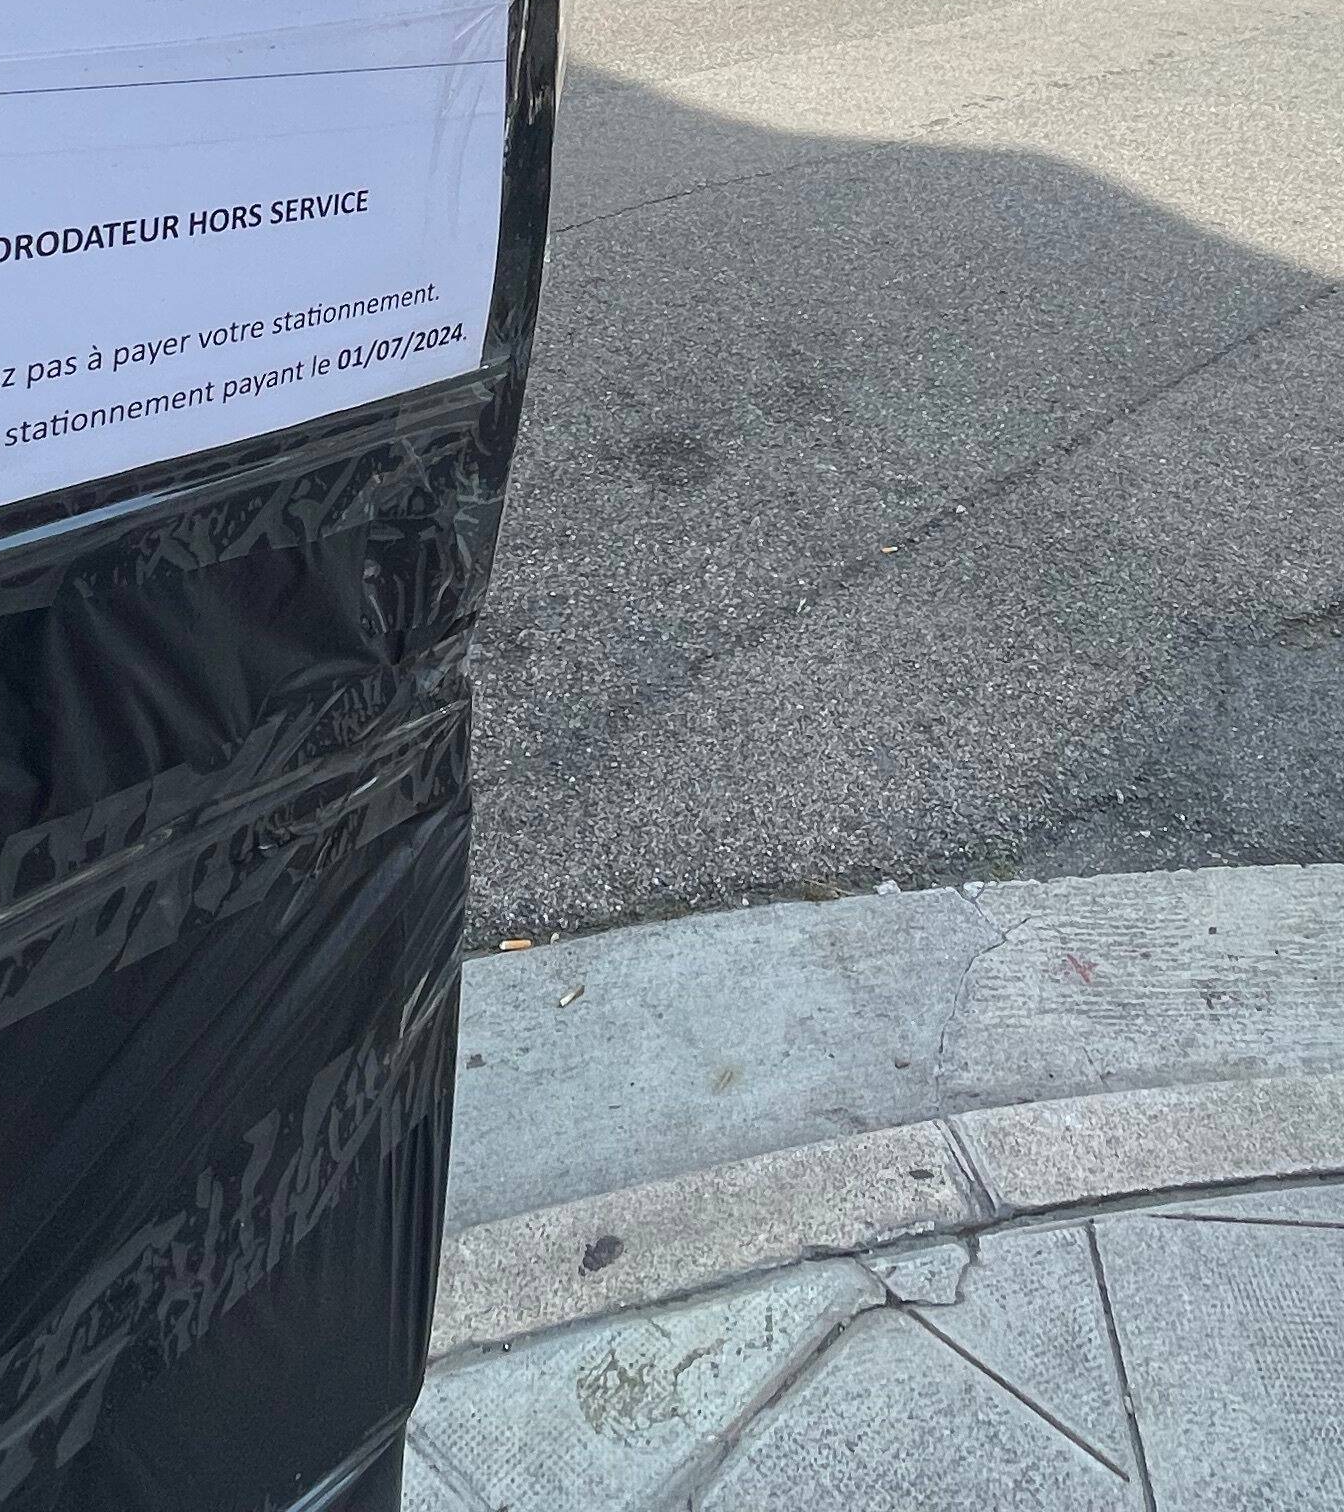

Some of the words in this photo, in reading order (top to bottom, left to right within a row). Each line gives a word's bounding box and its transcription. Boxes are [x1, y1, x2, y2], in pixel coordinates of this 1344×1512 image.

[188, 203, 262, 237] HORS
[269, 189, 369, 225] SERVICE
[4, 381, 216, 447] stationnement
[222, 360, 305, 404] payant
[310, 354, 331, 378] le
[337, 322, 468, 370] 01/07/2024.
[26, 356, 78, 390] pas
[87, 344, 102, 371] à
[112, 334, 192, 373] payer
[197, 320, 265, 349] votre
[271, 282, 441, 335] stationnement.
